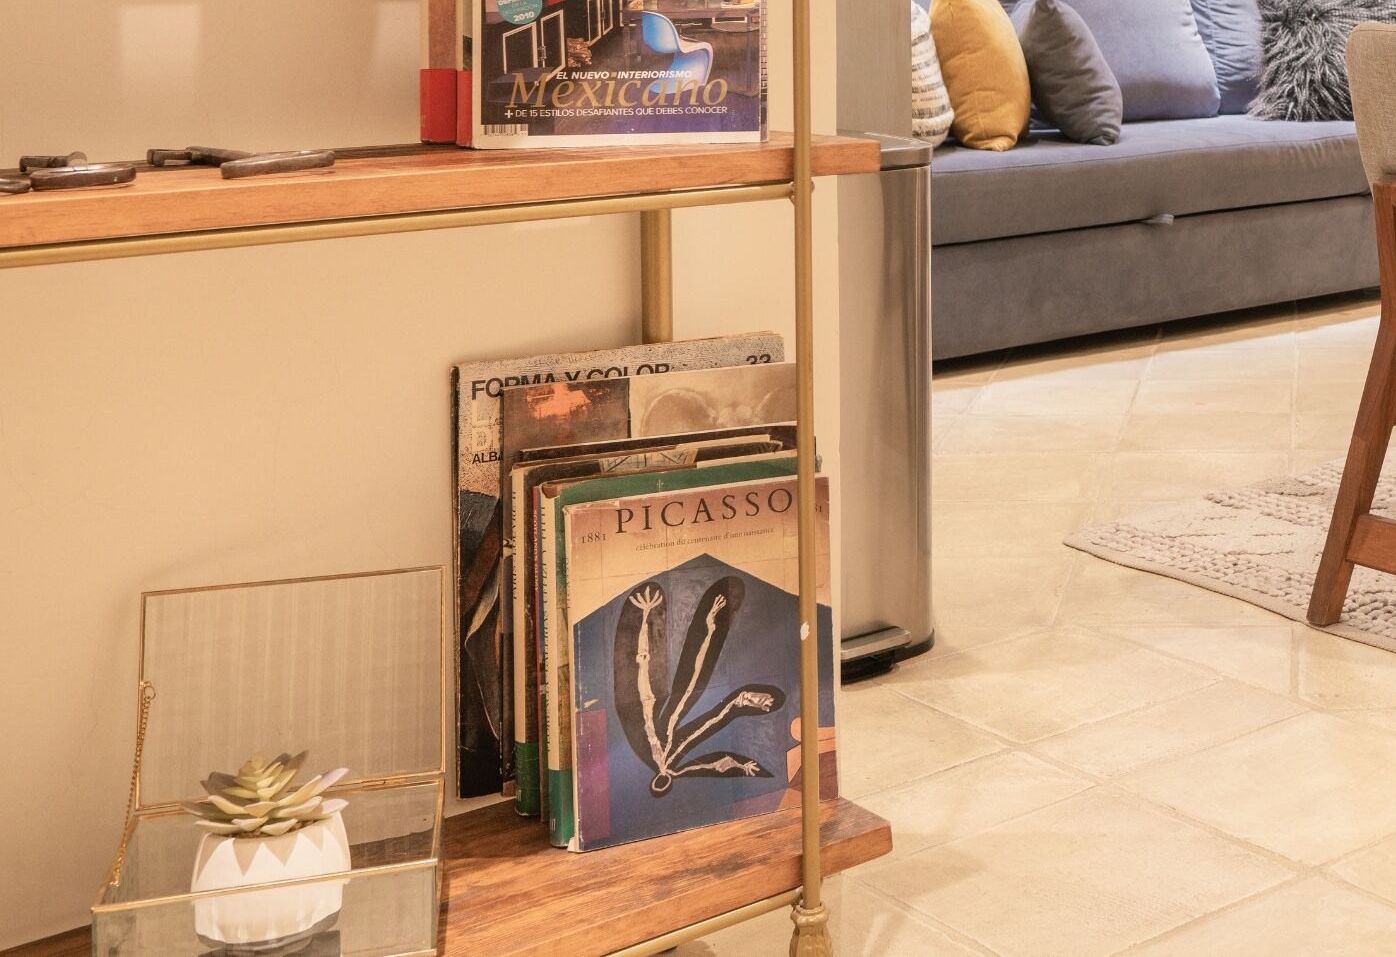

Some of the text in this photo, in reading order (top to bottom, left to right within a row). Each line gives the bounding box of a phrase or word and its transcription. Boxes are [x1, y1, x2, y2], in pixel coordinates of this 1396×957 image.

[513, 11, 535, 22] 2010
[556, 70, 692, 80] EL NUEVO INTERIORISMO
[505, 71, 728, 109] Mexicano
[515, 109, 528, 118] DE
[529, 109, 538, 118] 15
[539, 108, 575, 117] ESTILOS
[576, 107, 634, 117] DESAFIANTES
[636, 107, 654, 116] QUE
[655, 107, 683, 116] DEBES
[685, 106, 728, 115] CONOCER
[615, 488, 793, 534] PICASSO
[581, 531, 607, 544] 1881
[635, 528, 775, 552] célébration du centenaire d'une naissance
